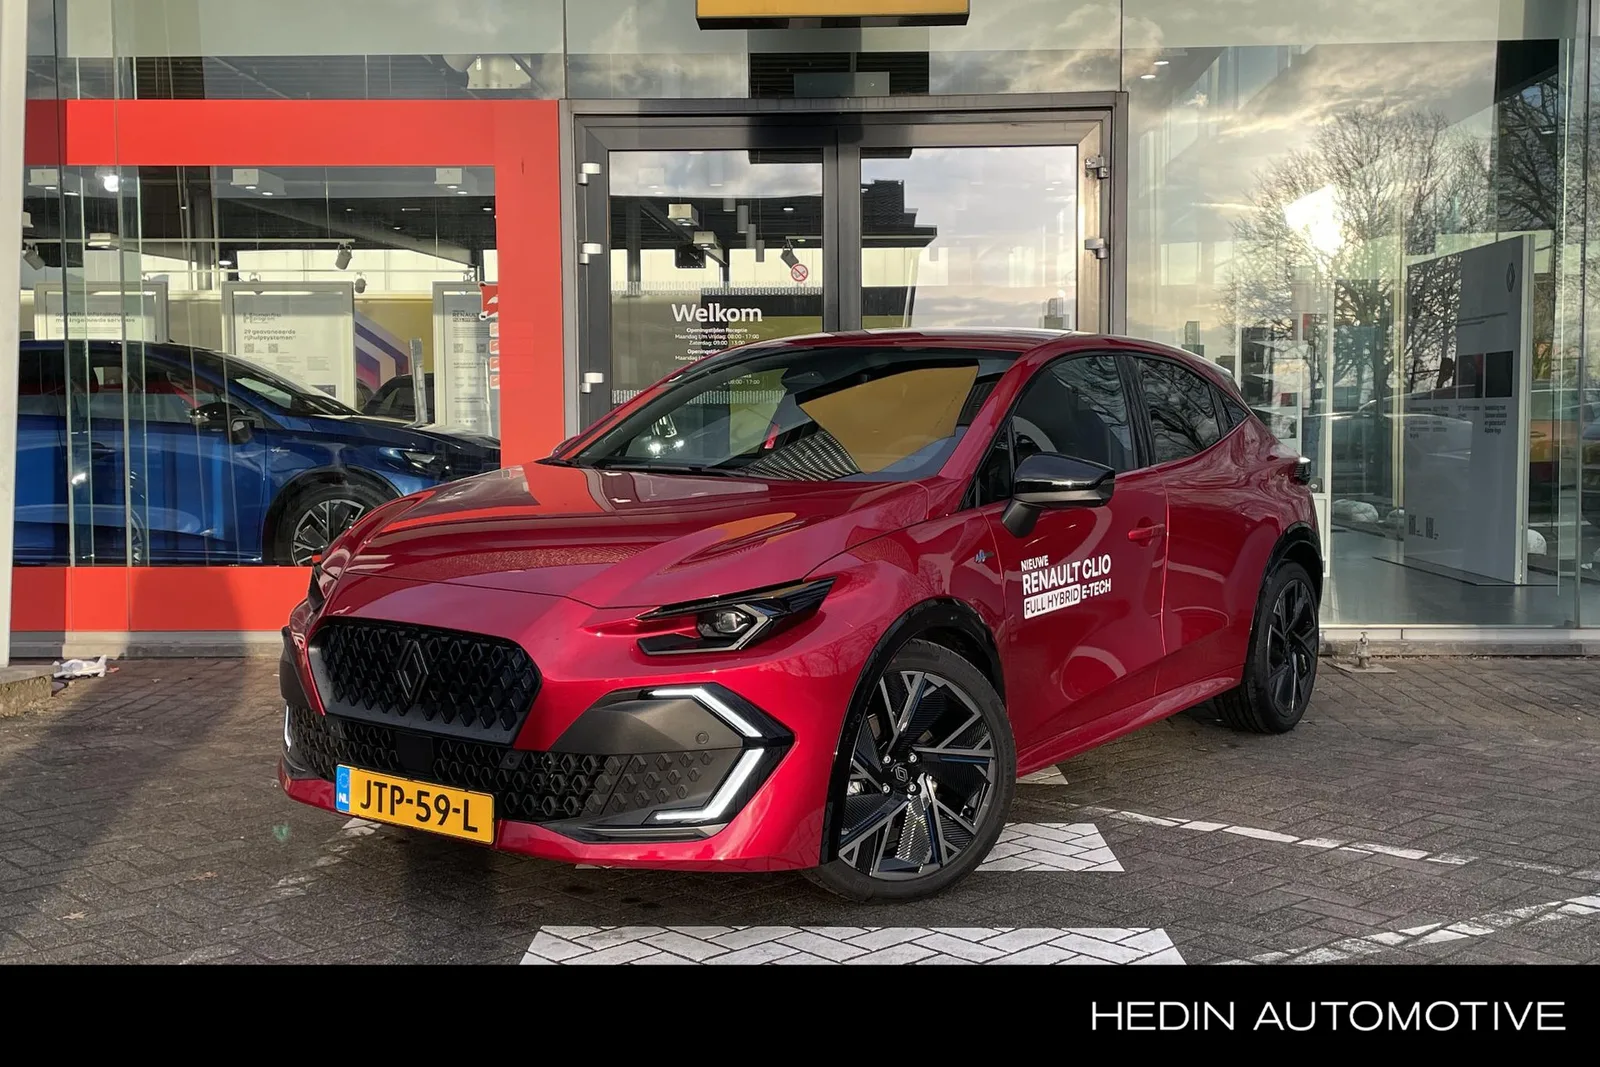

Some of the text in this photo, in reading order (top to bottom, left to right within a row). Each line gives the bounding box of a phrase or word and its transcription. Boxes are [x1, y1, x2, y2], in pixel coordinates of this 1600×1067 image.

[671, 303, 763, 322] Welkom
[1021, 555, 1049, 572] NIEUWE
[1022, 554, 1112, 595] RENAULT CLIO
[1025, 578, 1112, 616] FULL HYBRID E-TECH
[338, 792, 349, 804] NL
[360, 780, 478, 833] JTP-59-L
